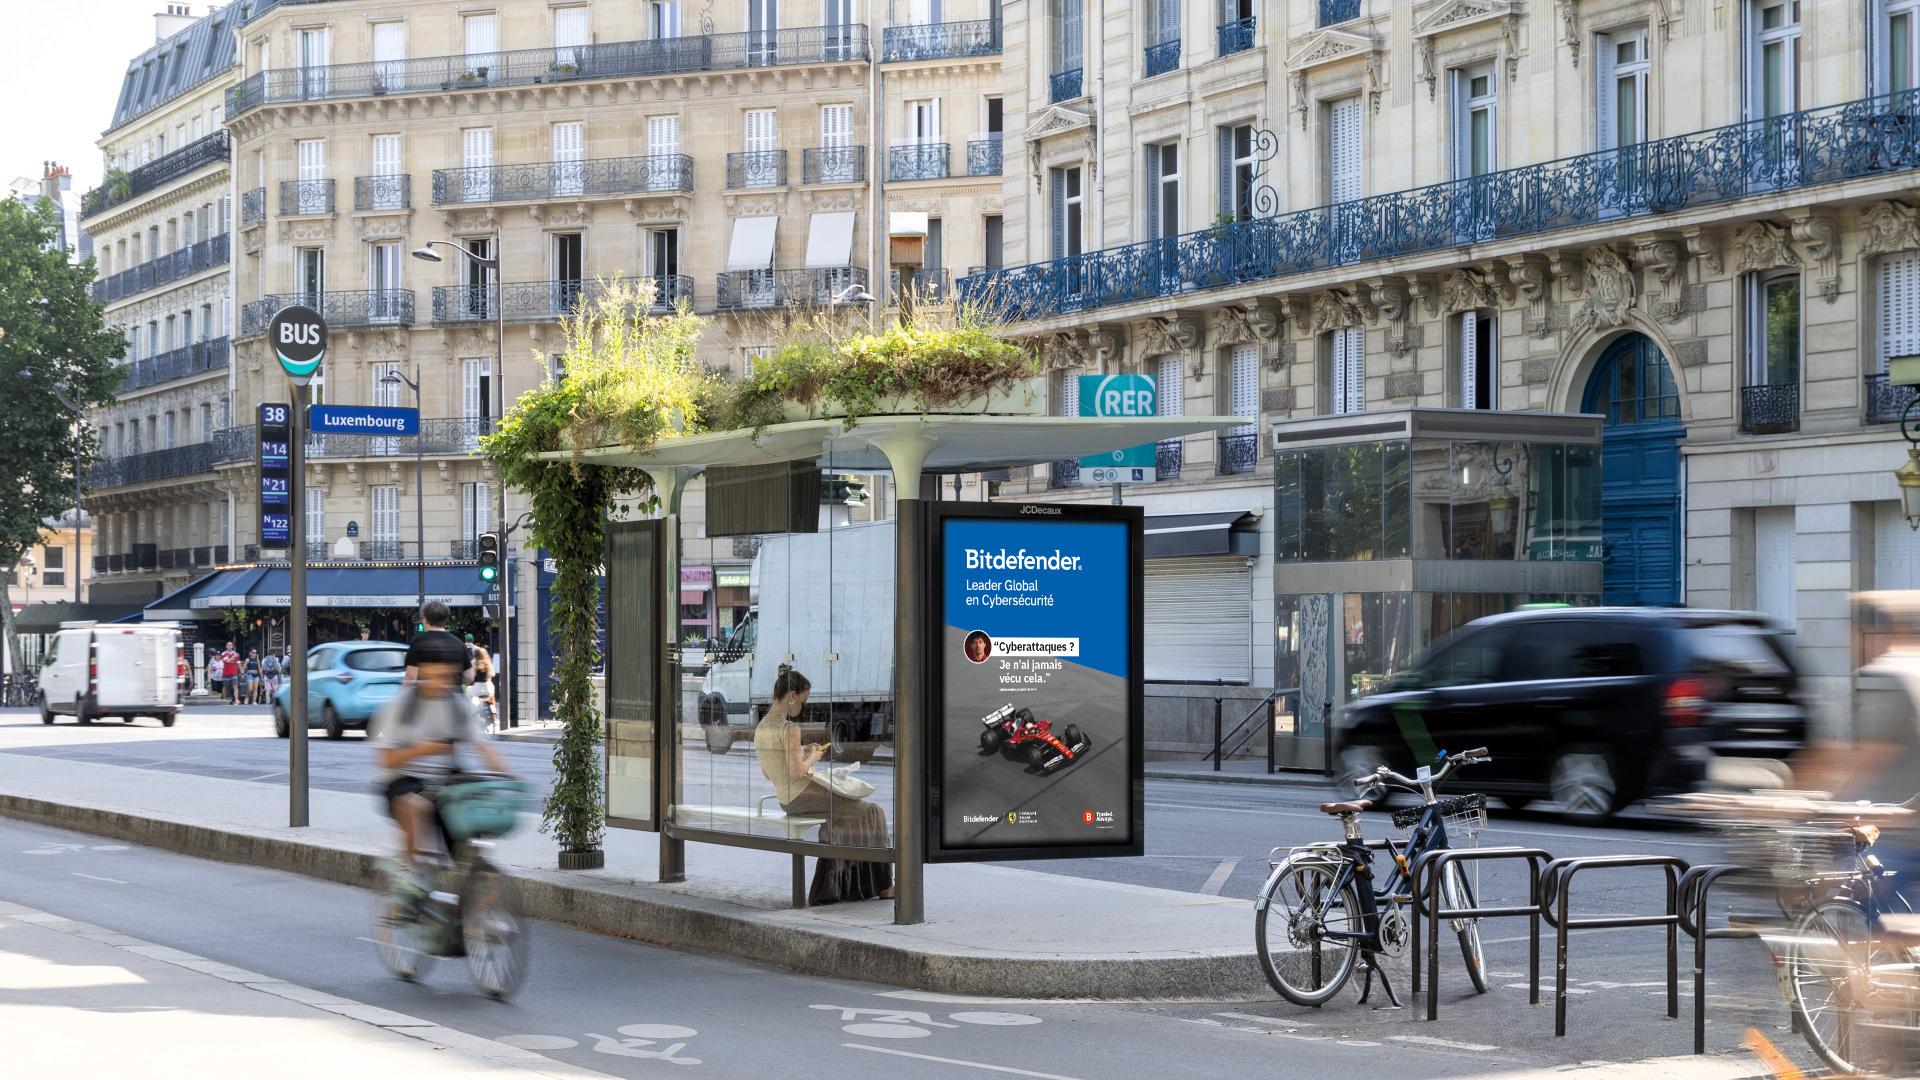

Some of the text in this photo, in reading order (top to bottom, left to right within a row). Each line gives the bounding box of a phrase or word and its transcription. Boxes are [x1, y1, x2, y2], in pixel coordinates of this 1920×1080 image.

[279, 322, 320, 345] BUS
[1105, 390, 1153, 415] RER
[264, 407, 285, 422] 38
[324, 413, 405, 431] Luxembourg
[1020, 505, 1062, 515] JCDecaux
[966, 579, 1039, 592] Leader Global
[966, 594, 1054, 608] en Cybersécurité
[1069, 641, 1075, 652] ?
[1000, 659, 1011, 670] Je
[1031, 659, 1063, 672] jamais
[1000, 672, 1021, 683] vécu
[963, 814, 999, 823] Bitdefender
